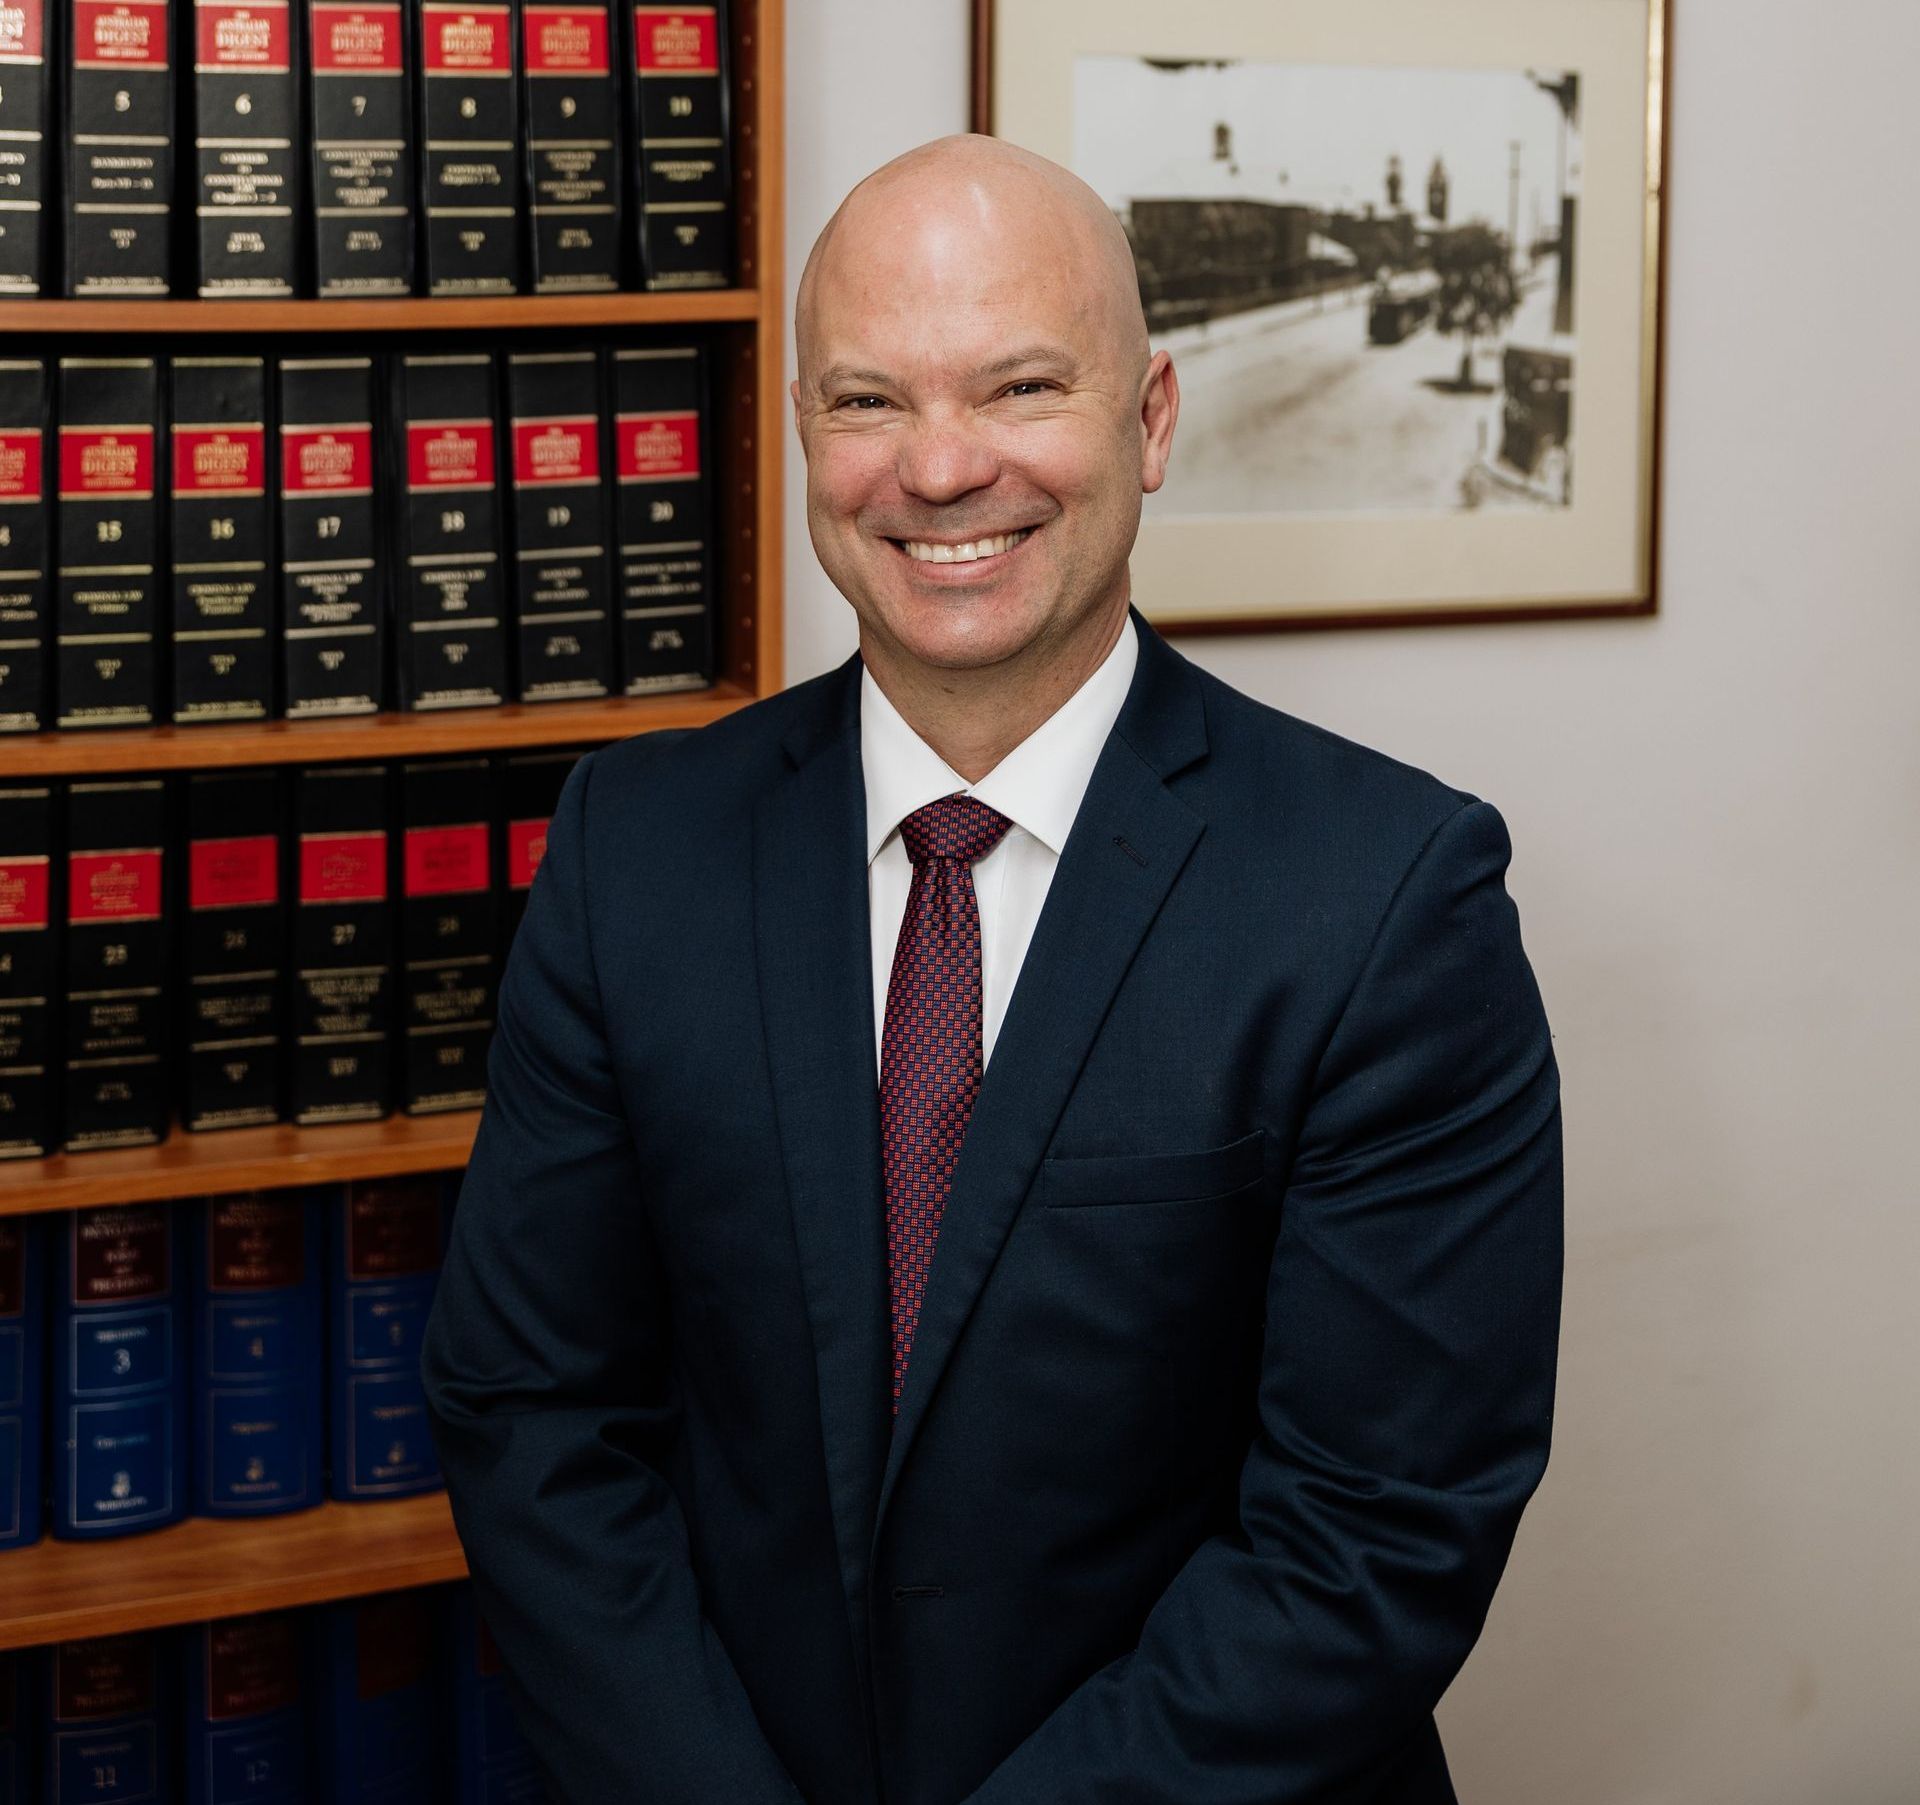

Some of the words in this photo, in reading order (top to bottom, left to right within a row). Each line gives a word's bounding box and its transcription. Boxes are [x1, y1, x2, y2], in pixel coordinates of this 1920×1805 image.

[95, 28, 149, 45] DIGEST
[215, 33, 270, 48] DIGEST
[332, 36, 384, 51] DIGEST
[441, 38, 493, 53] DIGEST
[541, 38, 590, 53] DIGEST
[653, 39, 701, 53] DIGEST
[115, 91, 130, 112] 5
[235, 93, 251, 114] 6
[351, 96, 366, 117] 7
[461, 96, 477, 118] 8
[560, 96, 576, 117] 9
[669, 96, 692, 117] 10
[81, 457, 138, 474] DIGEST
[194, 456, 249, 472] DIGEST
[300, 456, 354, 473] DIGEST
[441, 510, 465, 533] 18
[547, 506, 571, 528] 19
[650, 501, 674, 522] 20
[97, 520, 122, 543] 15
[210, 518, 235, 540] 16
[318, 516, 341, 538] 17
[112, 1348, 132, 1375] 3
